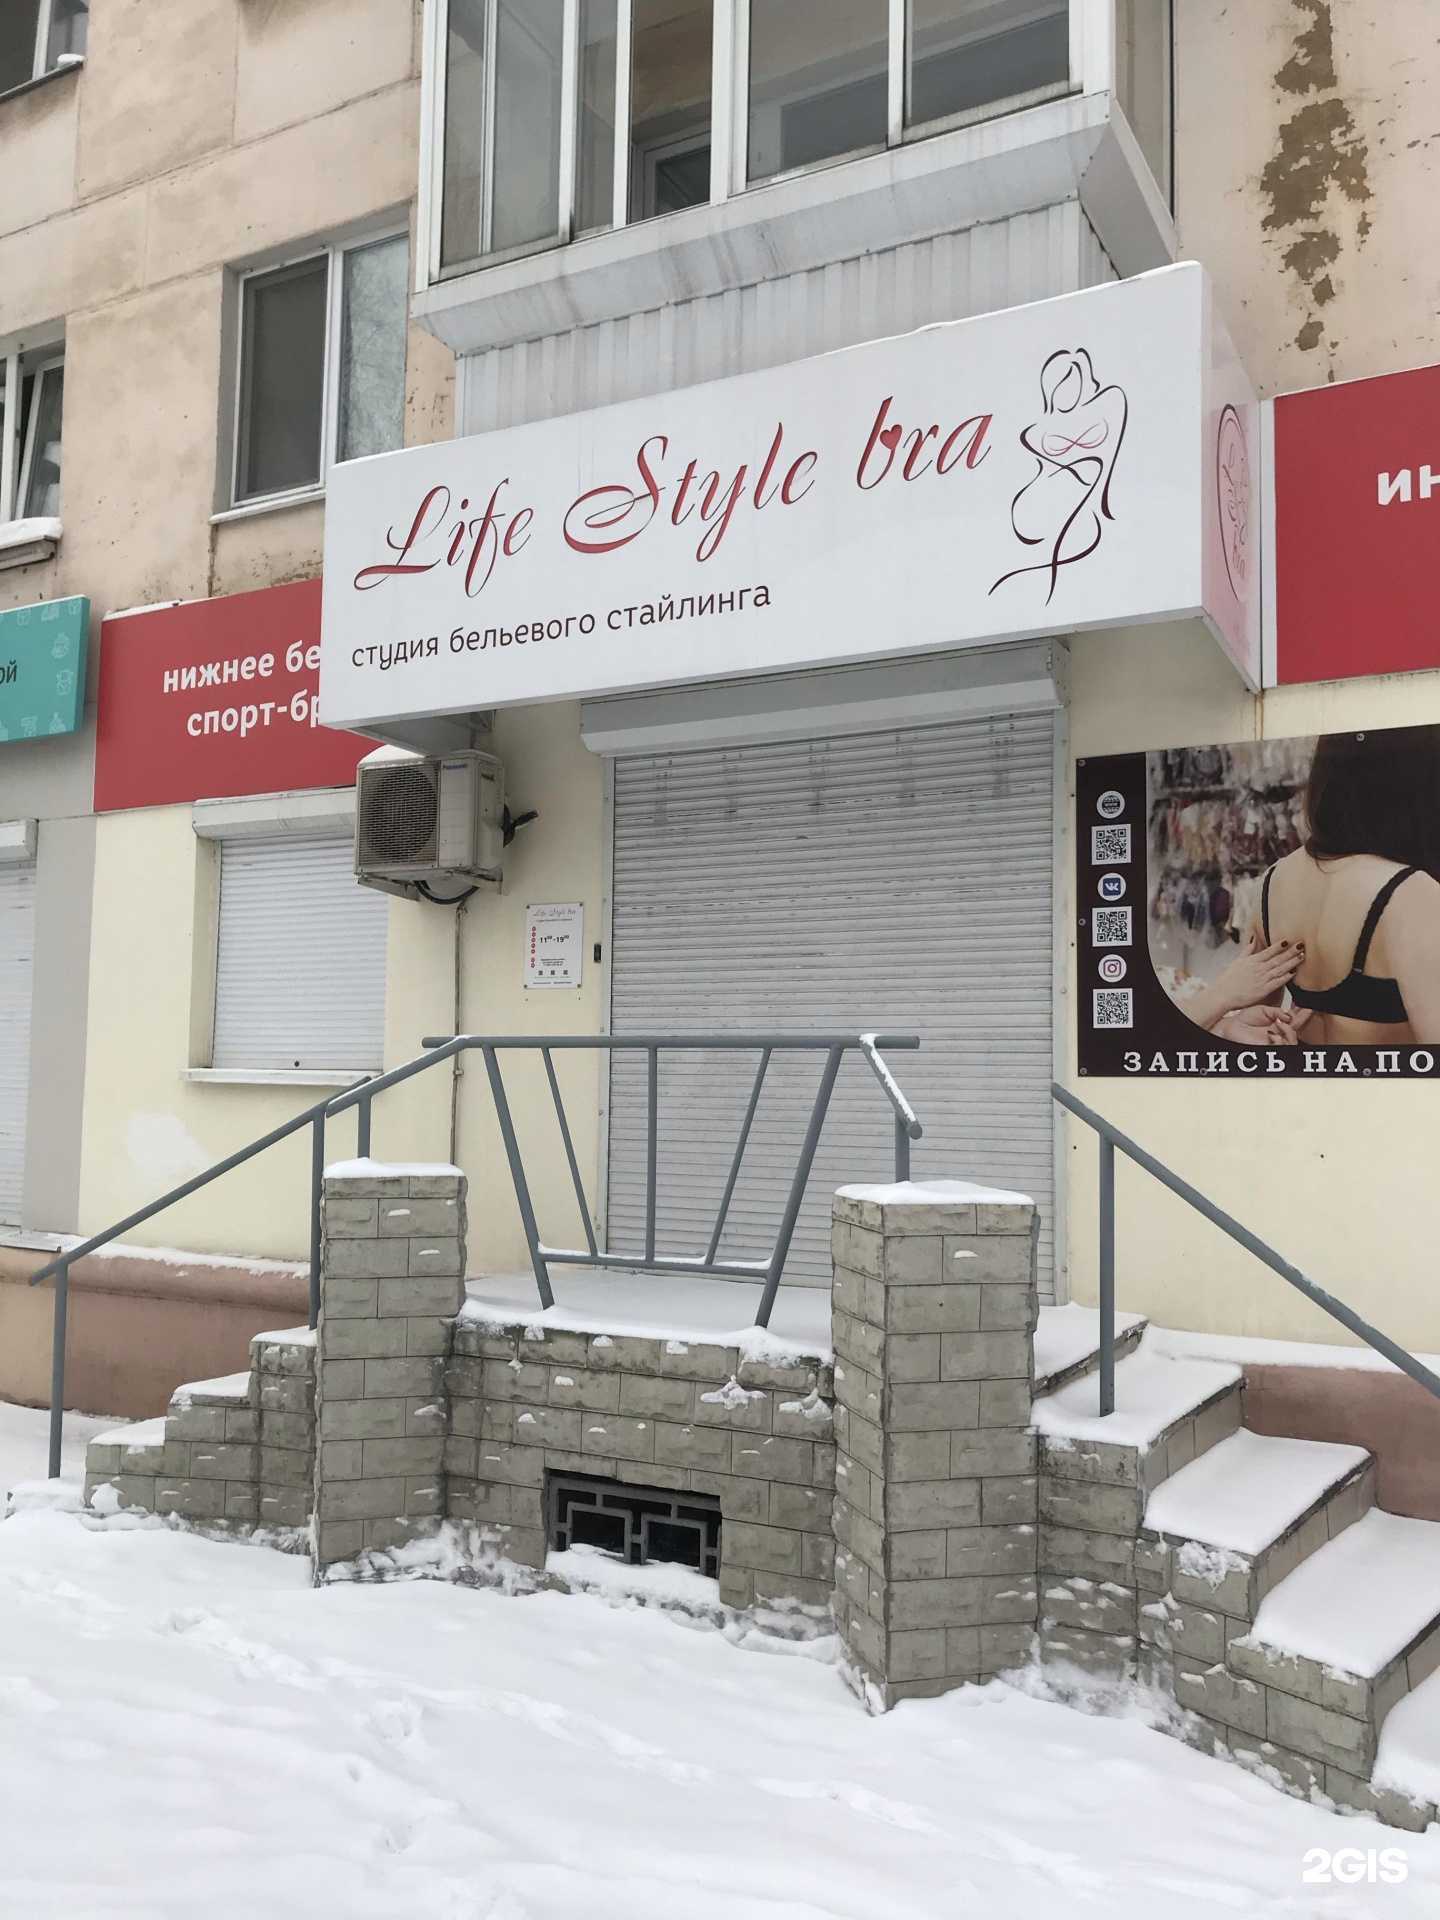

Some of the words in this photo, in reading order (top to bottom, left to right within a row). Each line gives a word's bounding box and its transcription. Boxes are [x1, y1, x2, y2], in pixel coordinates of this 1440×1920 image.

[354, 478, 534, 598] Life
[563, 422, 818, 562] Style
[857, 396, 993, 490] bra
[352, 636, 439, 671] студия
[449, 613, 596, 654] бельевого
[607, 584, 771, 630] стайлинга
[163, 652, 275, 693] нижнее
[285, 640, 321, 673] бе
[1123, 1051, 1286, 1073] ЗАПИСЬ
[1302, 1051, 1359, 1073] НА
[1375, 1051, 1435, 1073] ПО
